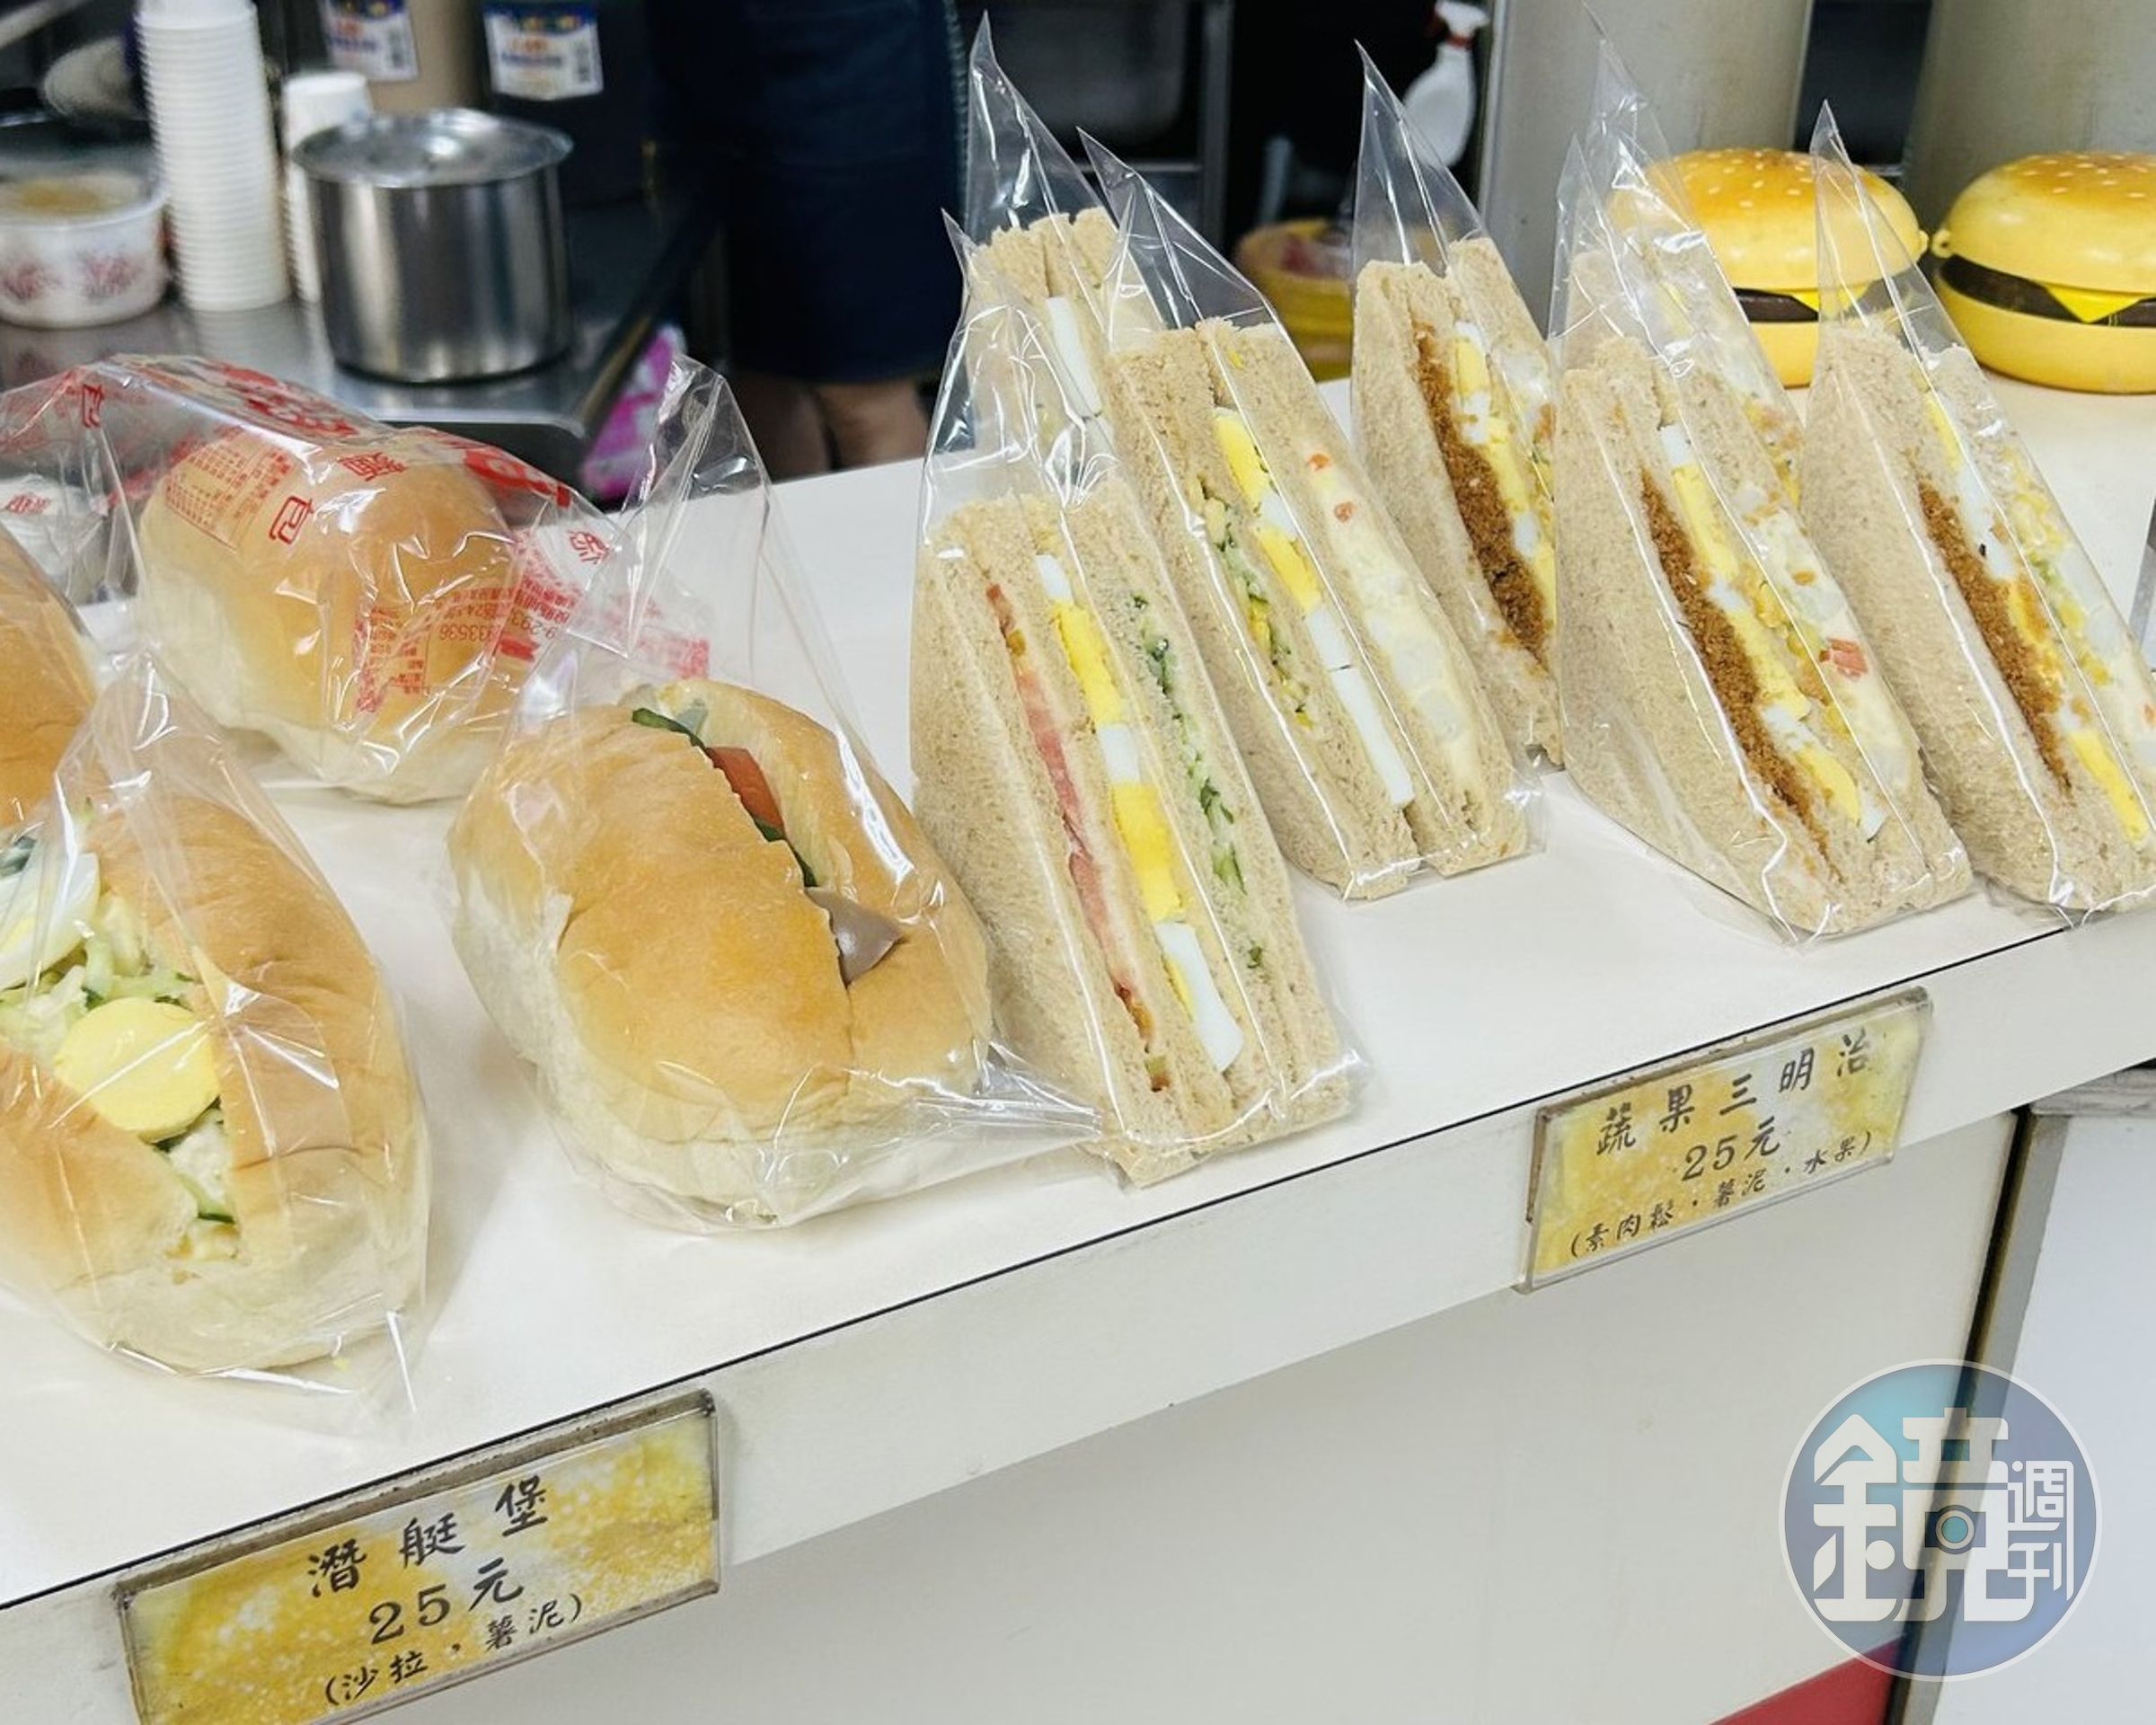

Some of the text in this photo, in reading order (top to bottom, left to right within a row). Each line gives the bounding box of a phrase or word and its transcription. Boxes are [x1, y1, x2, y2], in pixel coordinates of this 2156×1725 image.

[1595, 1029, 1871, 1156] 蔬果三明治
[1681, 1116, 1782, 1181] 25元
[306, 1474, 547, 1597] 潛艇堡
[368, 1555, 524, 1644] 25元
